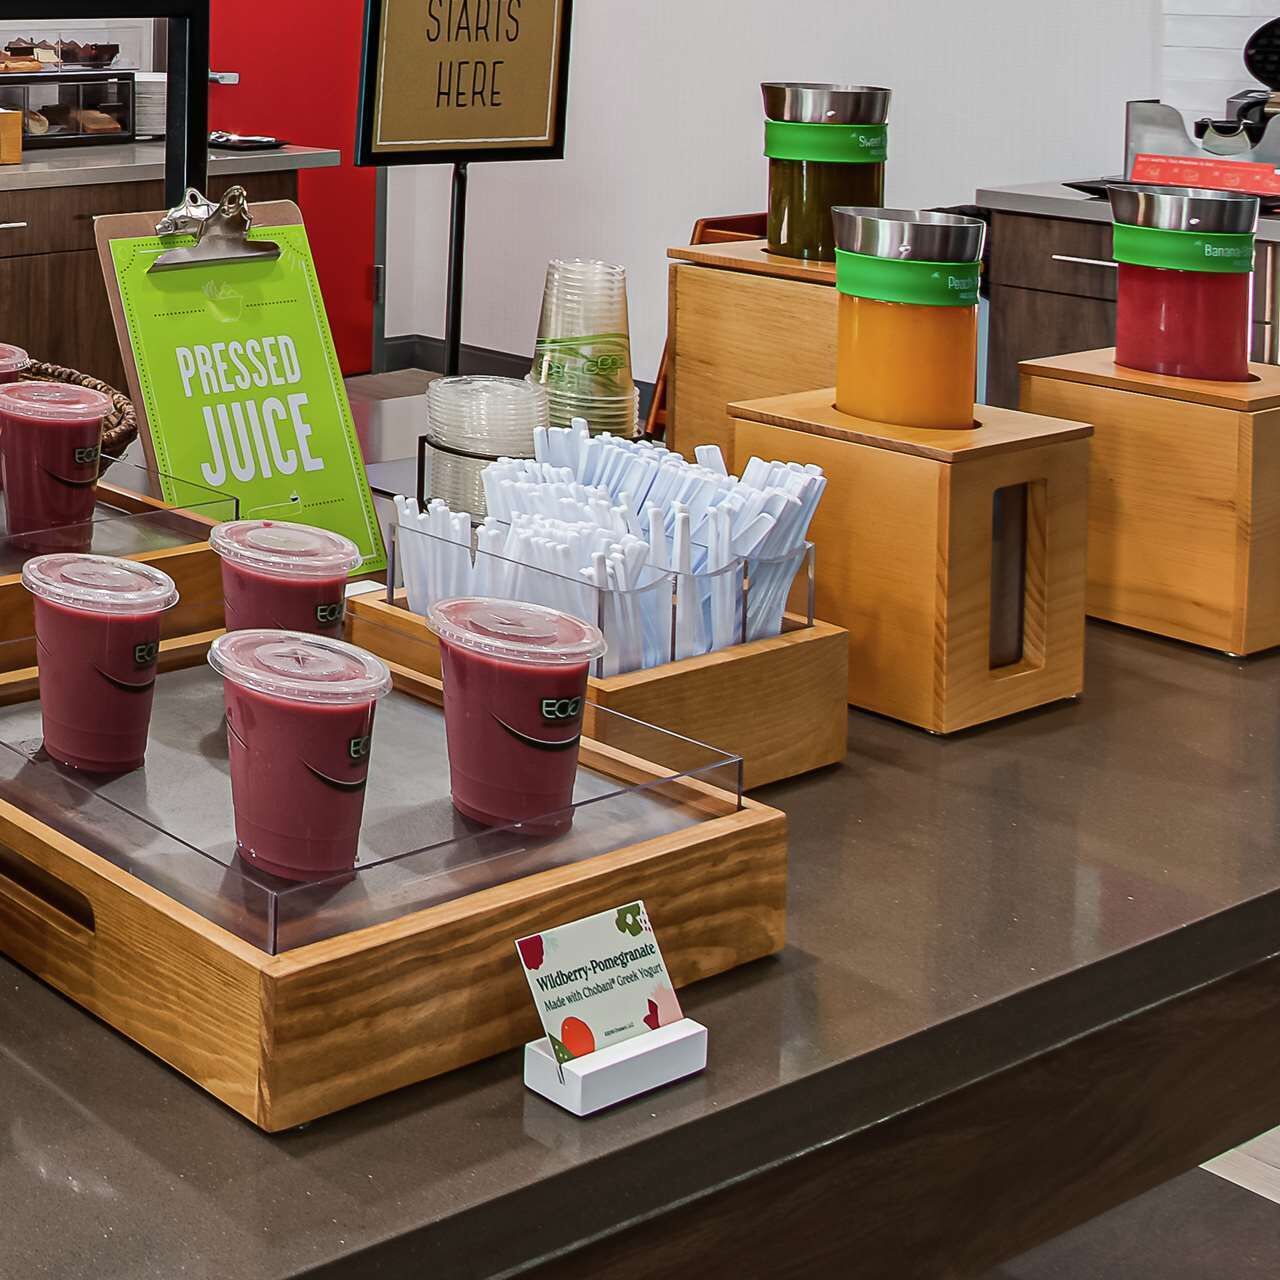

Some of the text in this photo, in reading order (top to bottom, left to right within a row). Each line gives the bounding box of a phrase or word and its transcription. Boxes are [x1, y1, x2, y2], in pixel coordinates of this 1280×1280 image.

[435, 60, 505, 109] HERE
[175, 334, 302, 398] PRESSED
[200, 393, 325, 487] JUICE
[536, 942, 657, 993] Wildberry-Pomegranate
[543, 996, 567, 1013] Made
[565, 989, 584, 1005] with
[617, 970, 640, 987] Greek
[639, 963, 664, 979] Yogurt
